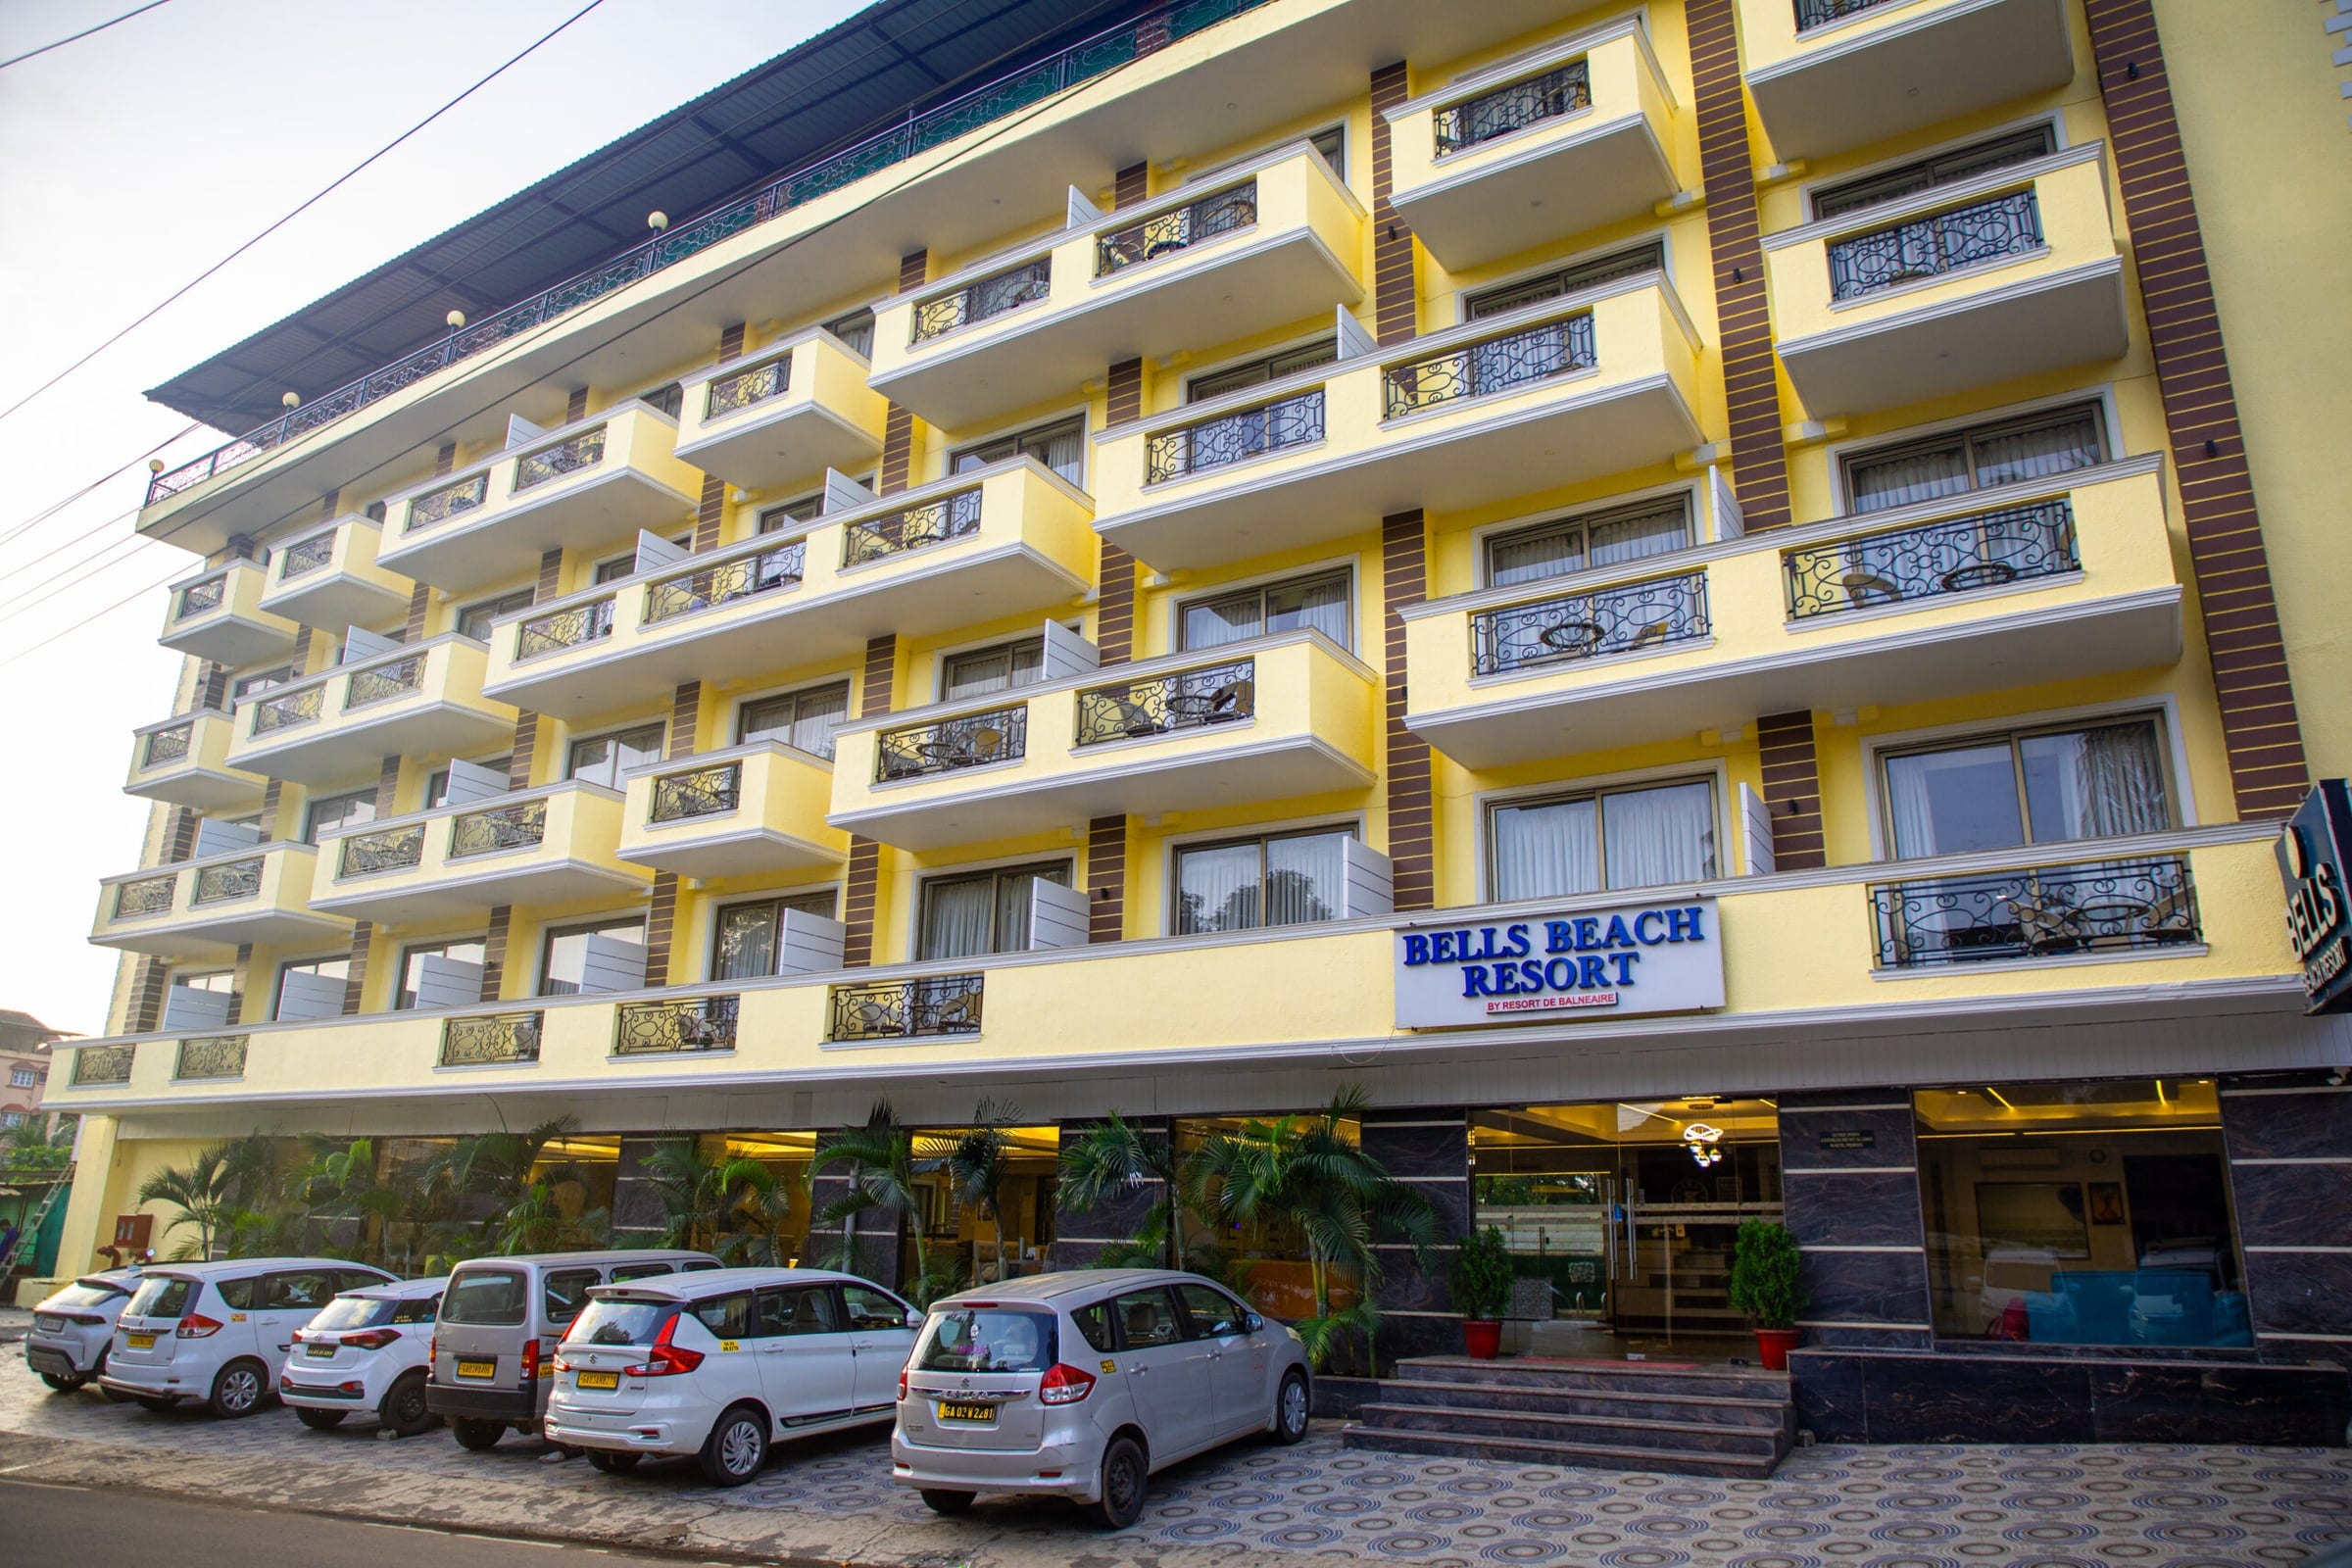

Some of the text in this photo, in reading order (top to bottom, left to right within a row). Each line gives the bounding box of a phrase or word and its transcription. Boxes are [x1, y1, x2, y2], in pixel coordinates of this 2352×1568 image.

[2283, 861, 2337, 962] BELLS
[1403, 906, 1704, 966] BELLS BEACH
[1461, 952, 1640, 998] RESORT
[1488, 993, 1615, 1011] BY RESORT DE BALNEAIRE
[946, 1406, 956, 1417] GA
[973, 1407, 993, 1419] 2281
